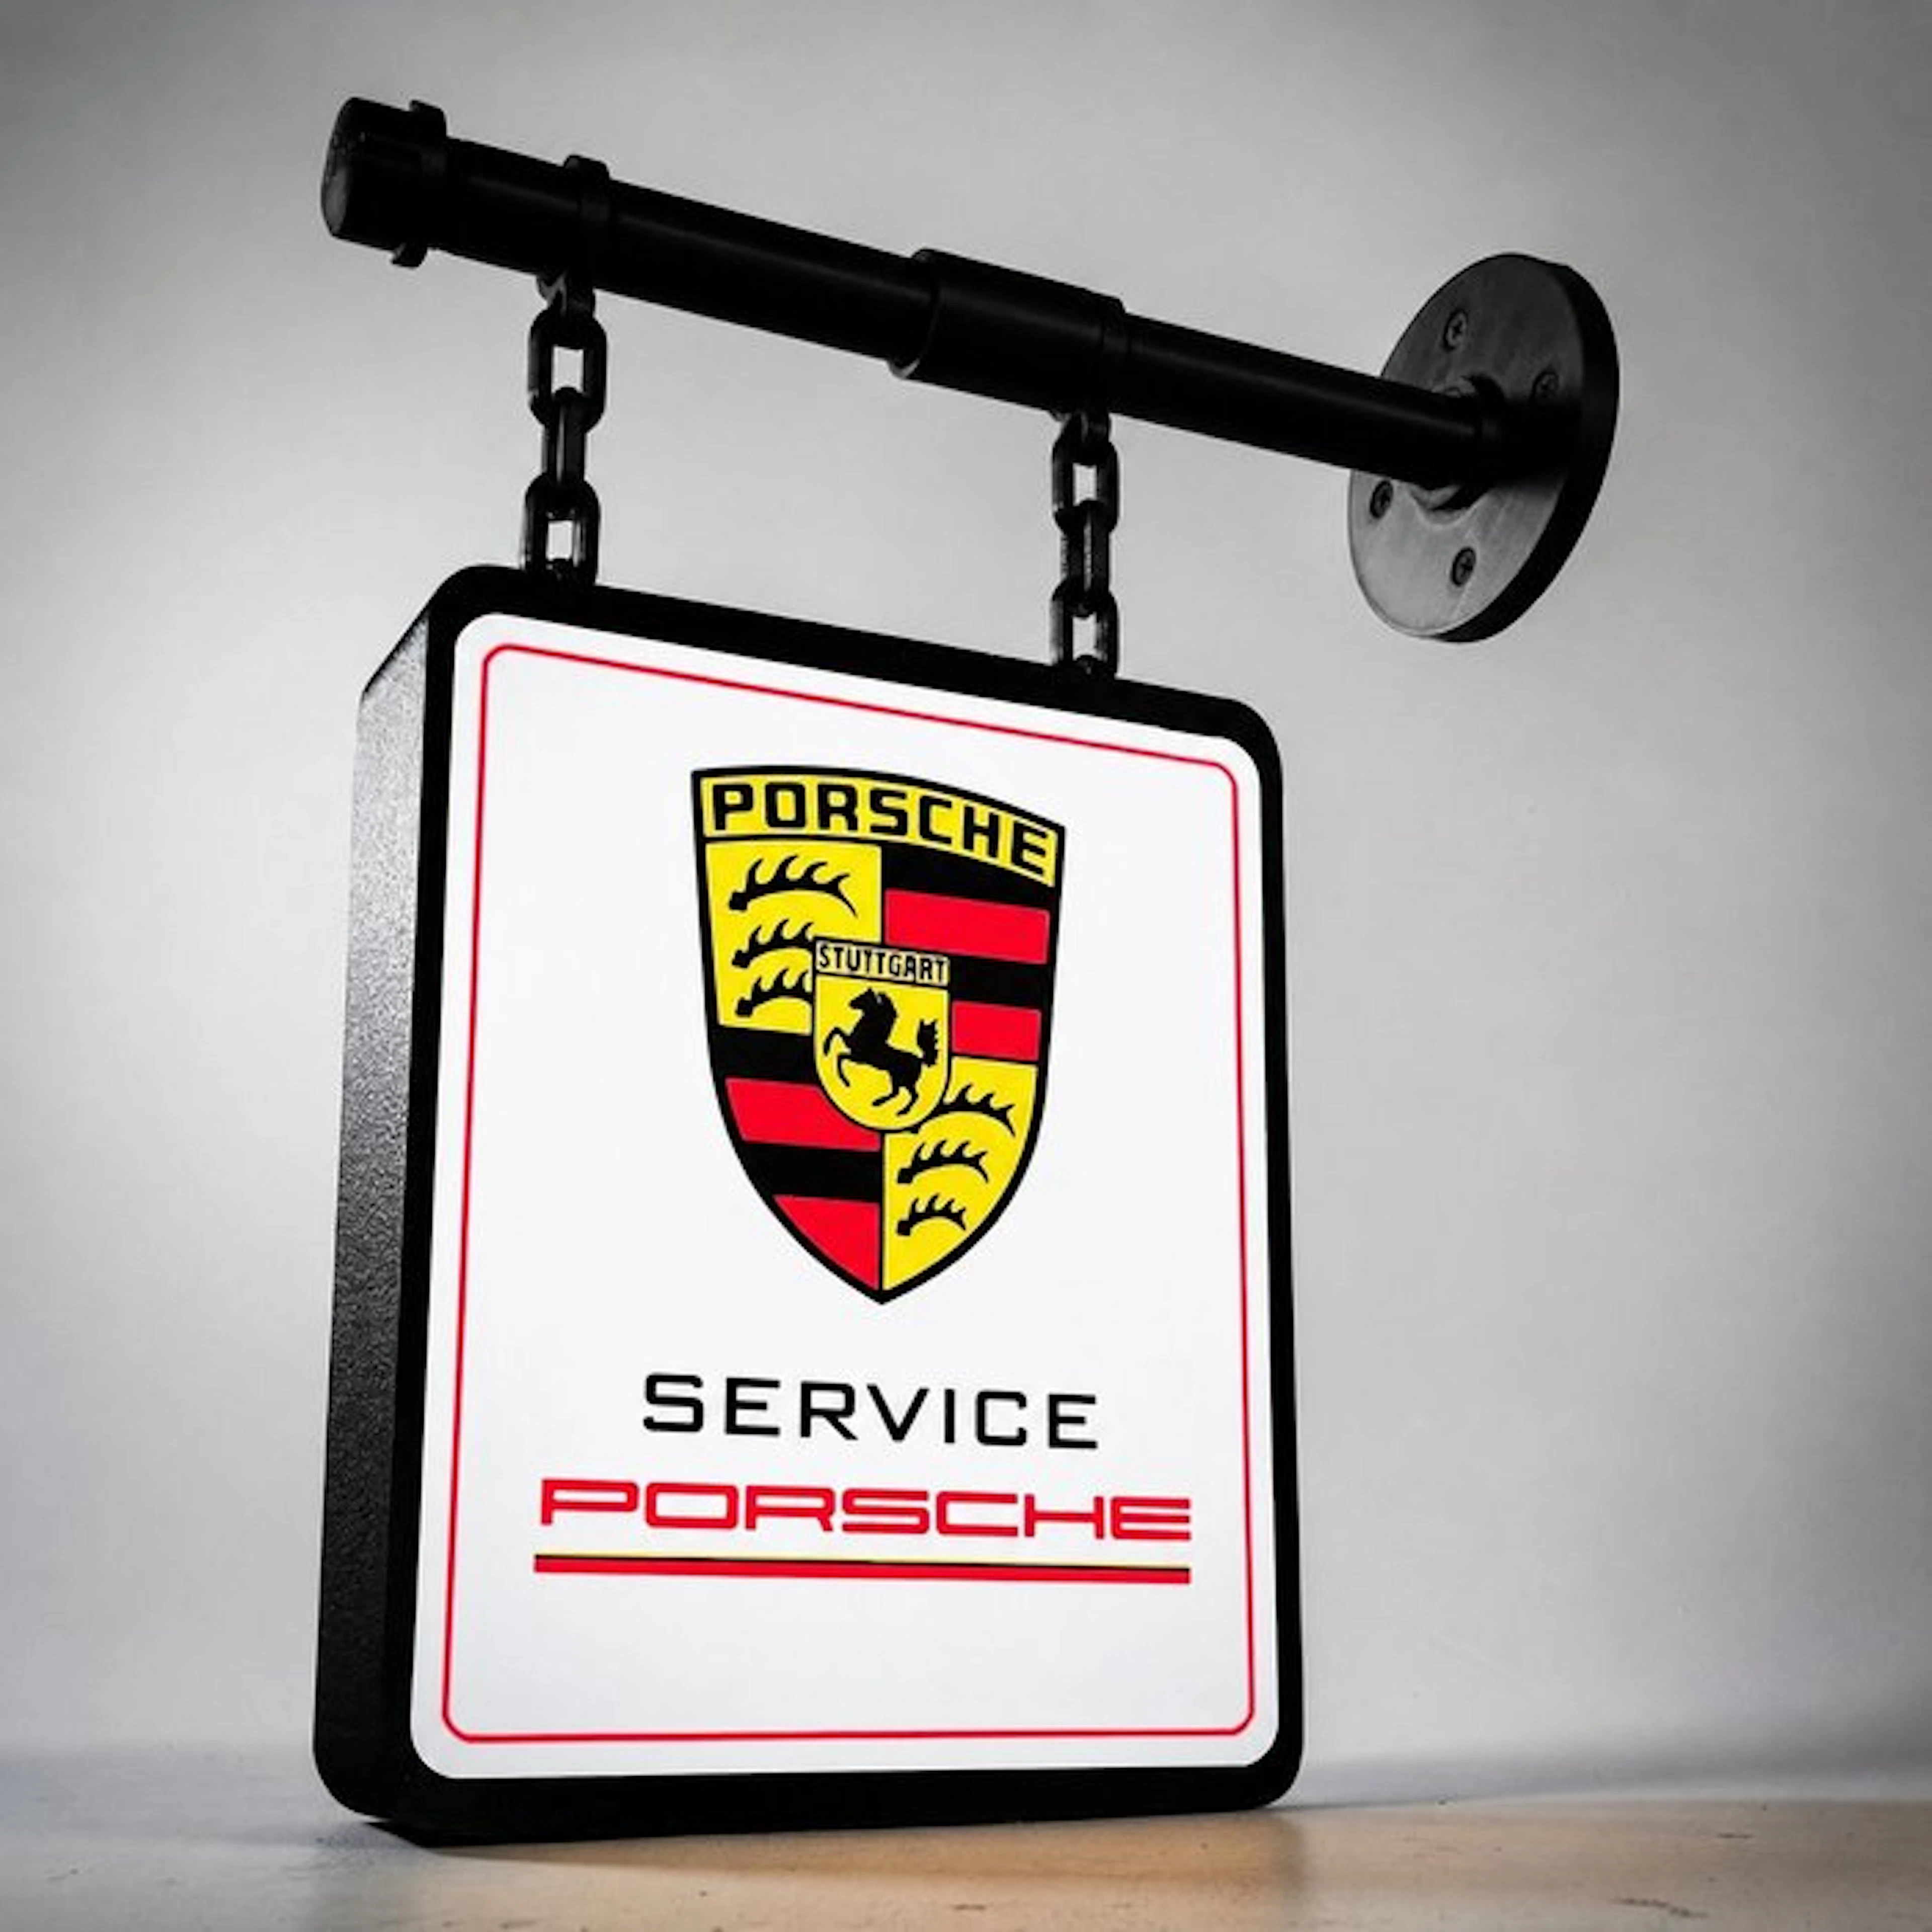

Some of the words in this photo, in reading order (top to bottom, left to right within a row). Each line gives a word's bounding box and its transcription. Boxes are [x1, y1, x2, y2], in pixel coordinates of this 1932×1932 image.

[713, 783, 1048, 876] PORSCHE
[819, 944, 944, 982] STUTTGART
[643, 1373, 1098, 1449] SERVICE
[540, 1479, 1191, 1541] PORSCHE
